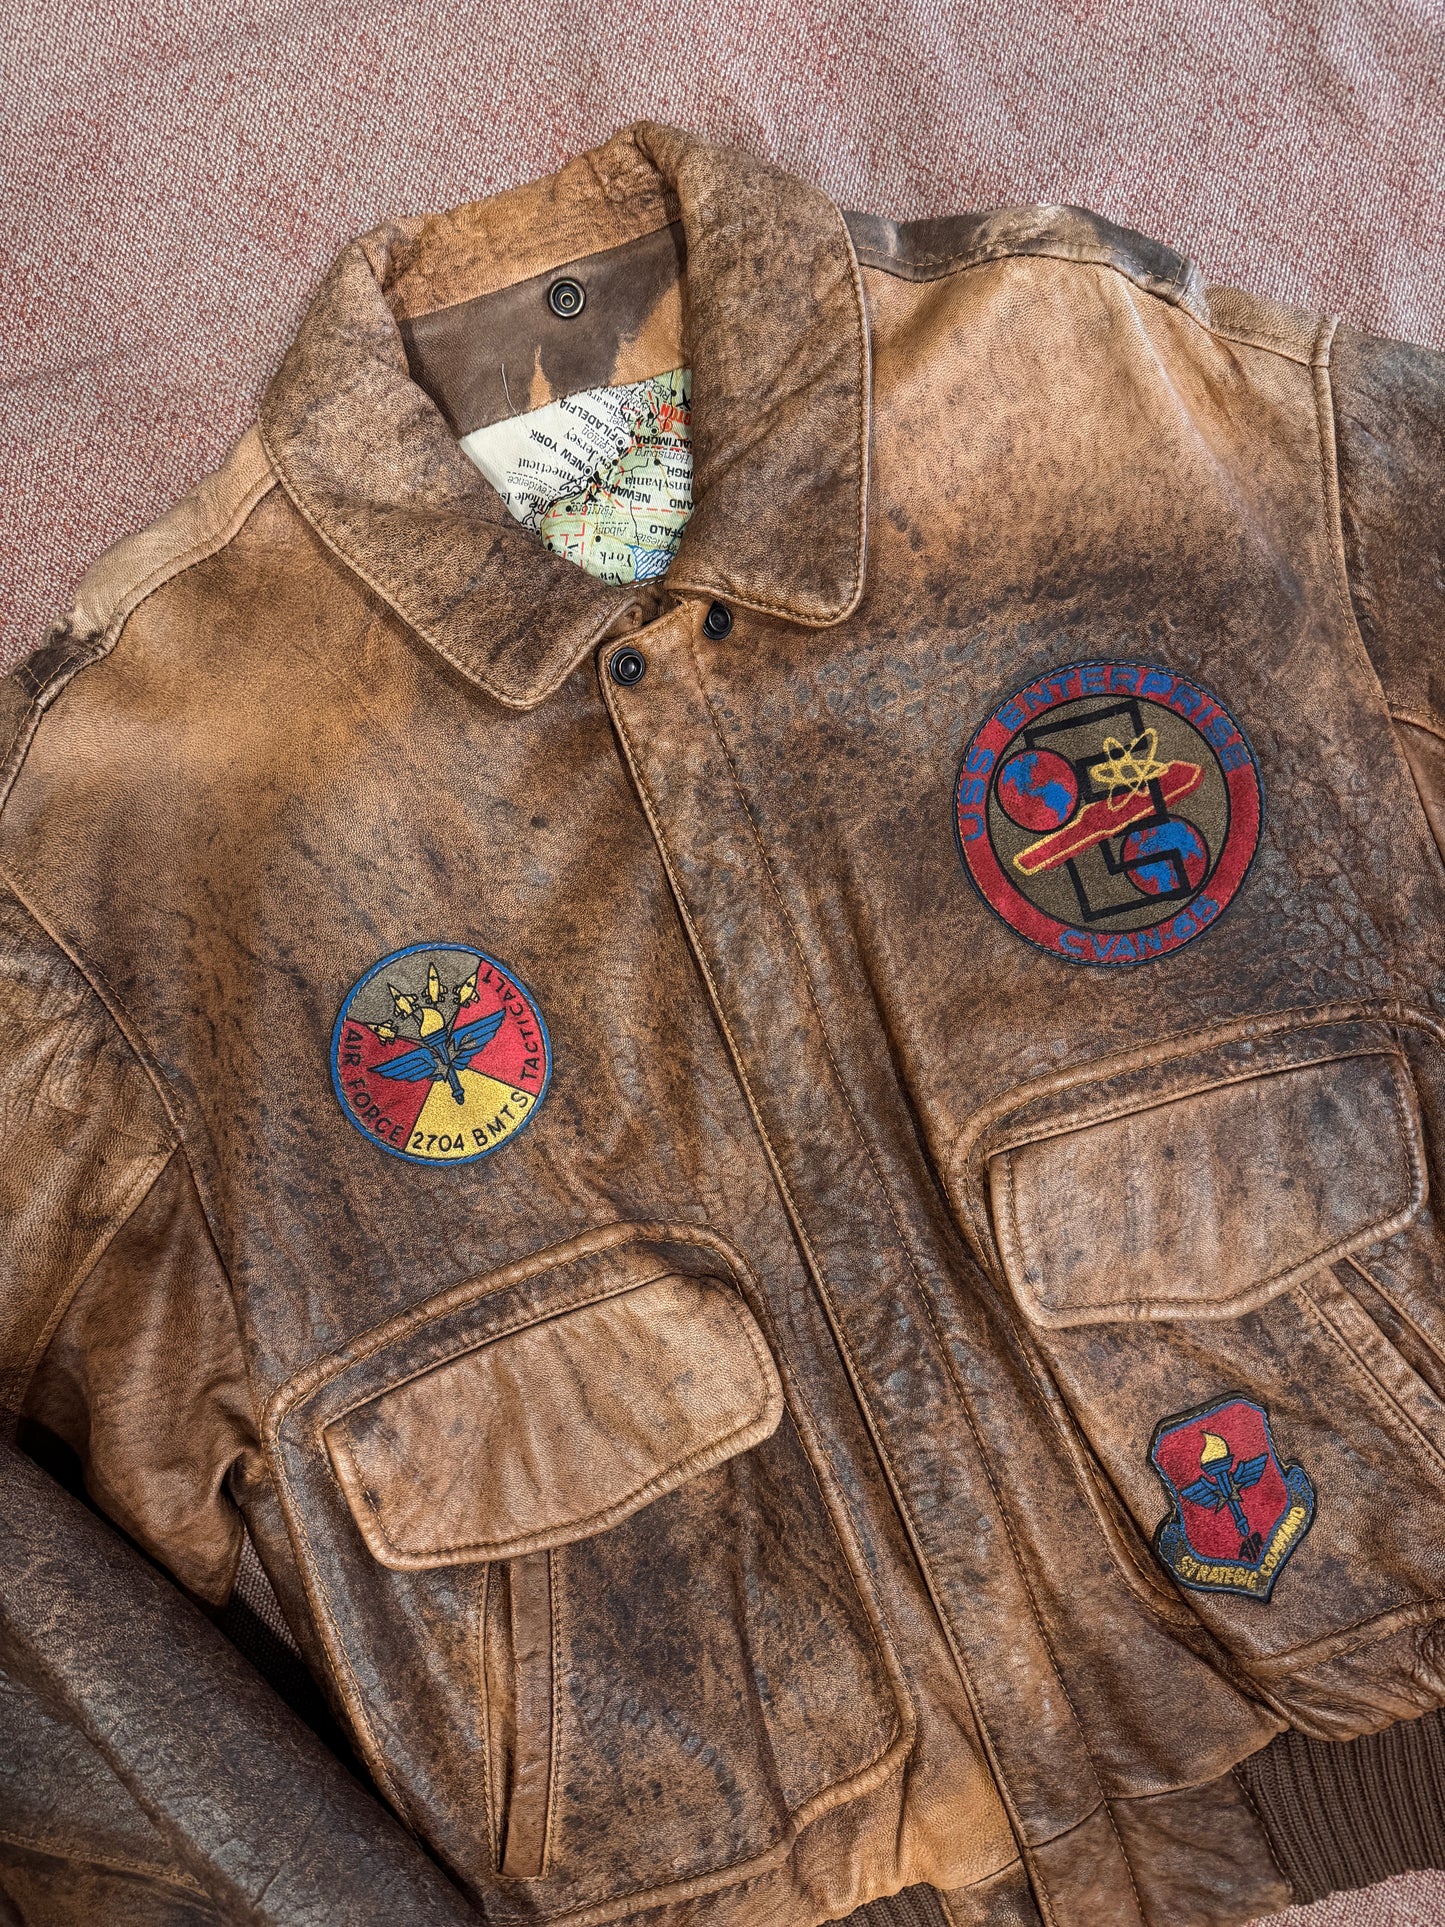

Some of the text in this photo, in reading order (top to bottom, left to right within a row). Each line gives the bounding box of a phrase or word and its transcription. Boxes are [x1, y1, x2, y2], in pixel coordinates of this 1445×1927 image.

[559, 398, 618, 441] FILADELFIA
[529, 429, 586, 472] NEW YORK
[563, 430, 598, 462] Jersey
[581, 426, 615, 460] Trenton
[602, 482, 651, 503] NEWARK
[625, 476, 692, 491] nnsylvania
[669, 498, 694, 511] AND
[649, 524, 684, 539] FFALO
[599, 551, 632, 568] York
[959, 667, 1250, 842] USS ENTERPRISE
[344, 1029, 404, 1143] AIR FORCE
[412, 1132, 465, 1152] 2704
[1175, 1506, 1306, 1589] STRATEGIC COMMAND
